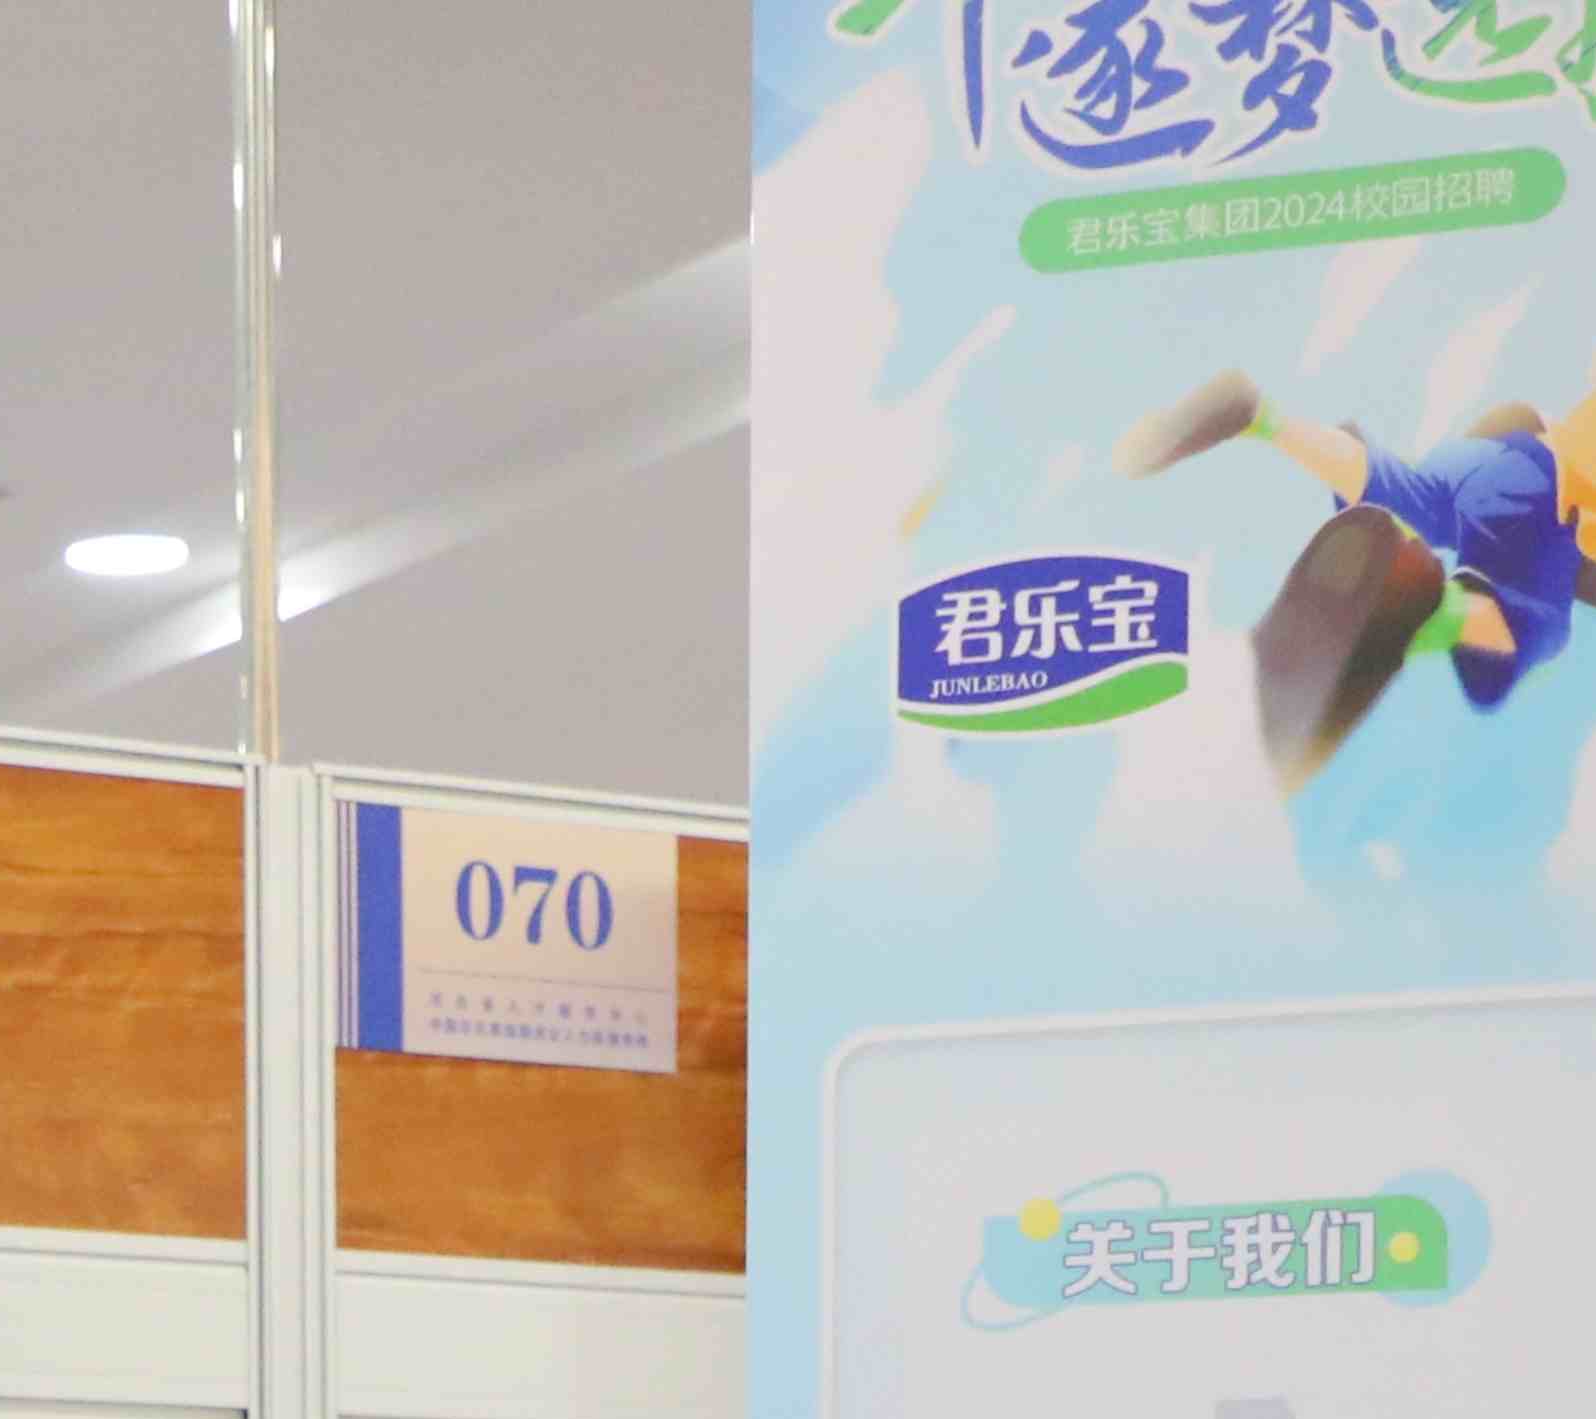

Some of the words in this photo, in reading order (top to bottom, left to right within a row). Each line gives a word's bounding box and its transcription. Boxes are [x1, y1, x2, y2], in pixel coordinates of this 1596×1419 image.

[1065, 165, 1517, 256] 君乐宝集团2024校园招聘
[933, 575, 1159, 667] 君乐宝
[929, 669, 1049, 700] JUNLEBAO
[455, 860, 615, 951] 070
[1062, 1206, 1378, 1298] 关于我们
